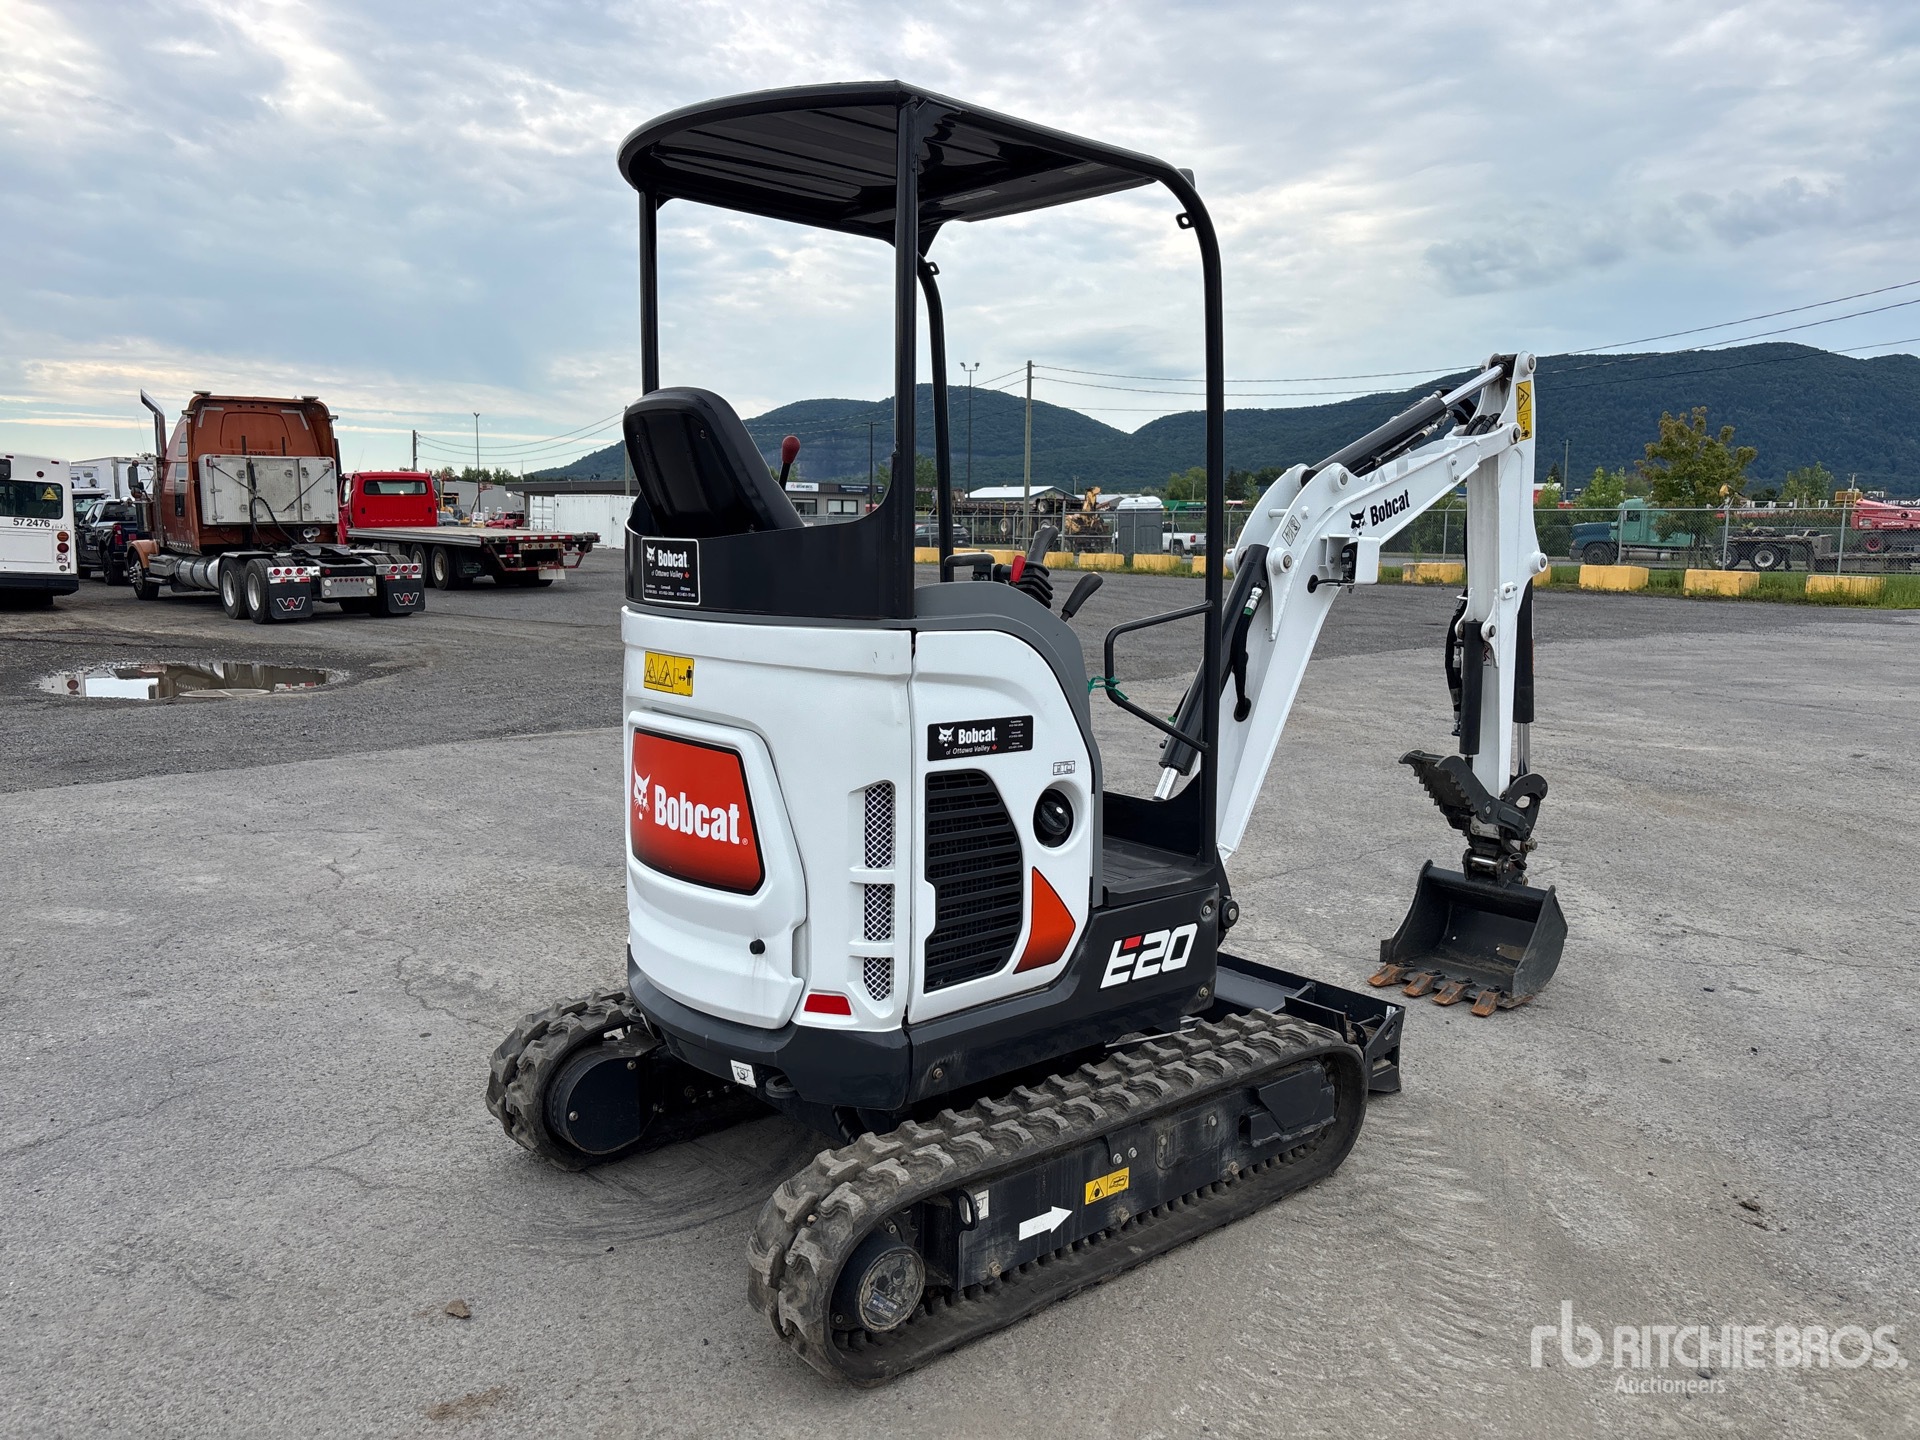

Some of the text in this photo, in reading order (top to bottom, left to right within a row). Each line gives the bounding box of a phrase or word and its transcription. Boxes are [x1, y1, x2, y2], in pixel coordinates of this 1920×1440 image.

[1369, 488, 1410, 527] Bobcat
[657, 550, 687, 568] Bobcat
[655, 569, 669, 577] Ottawa
[670, 570, 684, 580] Valley
[958, 726, 996, 744] Bobcat
[952, 746, 973, 755] Ottawa
[974, 744, 990, 753] Valley
[655, 784, 740, 845] Bobcat
[1100, 923, 1198, 989] E20
